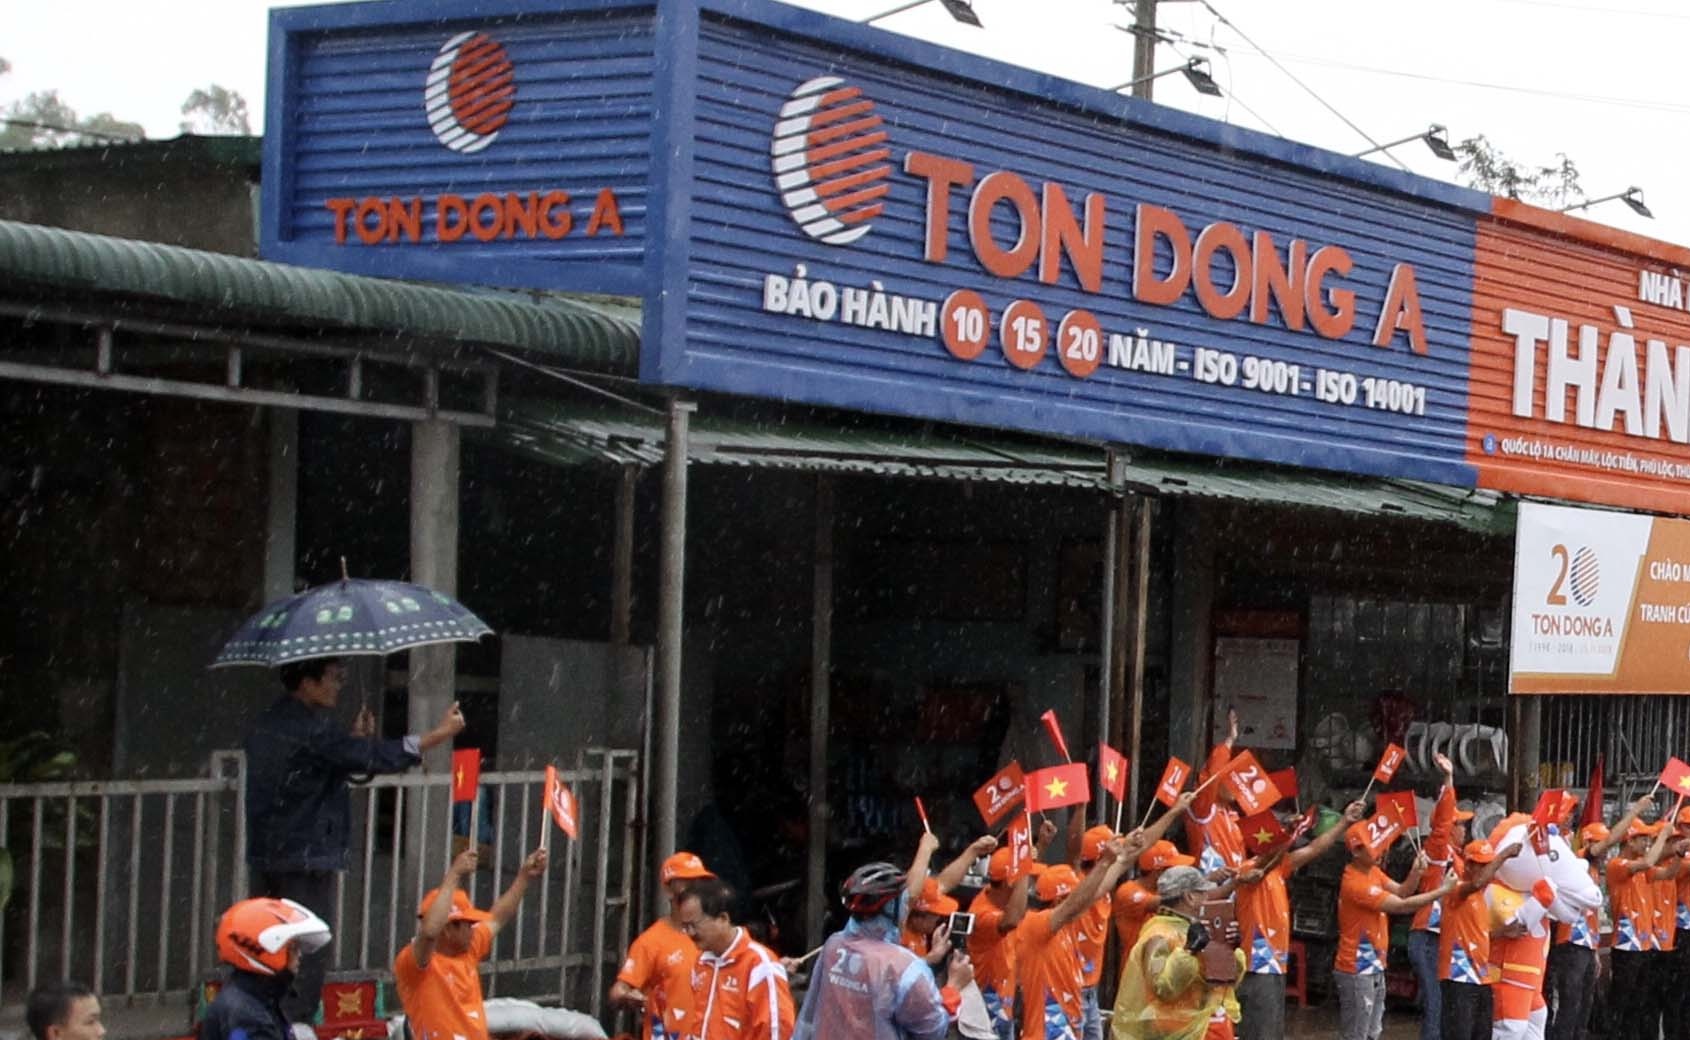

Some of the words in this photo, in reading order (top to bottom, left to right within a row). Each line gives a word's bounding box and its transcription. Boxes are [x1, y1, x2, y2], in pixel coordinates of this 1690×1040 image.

[325, 197, 422, 246] TON
[436, 189, 573, 244] DONG
[586, 186, 625, 237] A
[904, 151, 1106, 294] TON
[1133, 202, 1356, 341] DONG
[1373, 261, 1428, 356] A
[1639, 268, 1684, 311] NHÀ
[764, 264, 838, 321] BẢO
[840, 280, 937, 339] HÀNH
[953, 306, 983, 344] 10
[1012, 315, 1041, 352] 15
[1066, 324, 1098, 361] 20
[1109, 327, 1175, 377] NĂM
[1193, 347, 1237, 386] ISO
[1316, 368, 1358, 407] ISO
[1363, 376, 1427, 418] 14001
[1501, 437, 1529, 456] QUỐC
[1650, 558, 1681, 582] CHÀO
[1531, 613, 1560, 636] TON
[1563, 615, 1601, 638] DONG
[1603, 618, 1614, 638] A
[1640, 603, 1676, 624] TRANH
